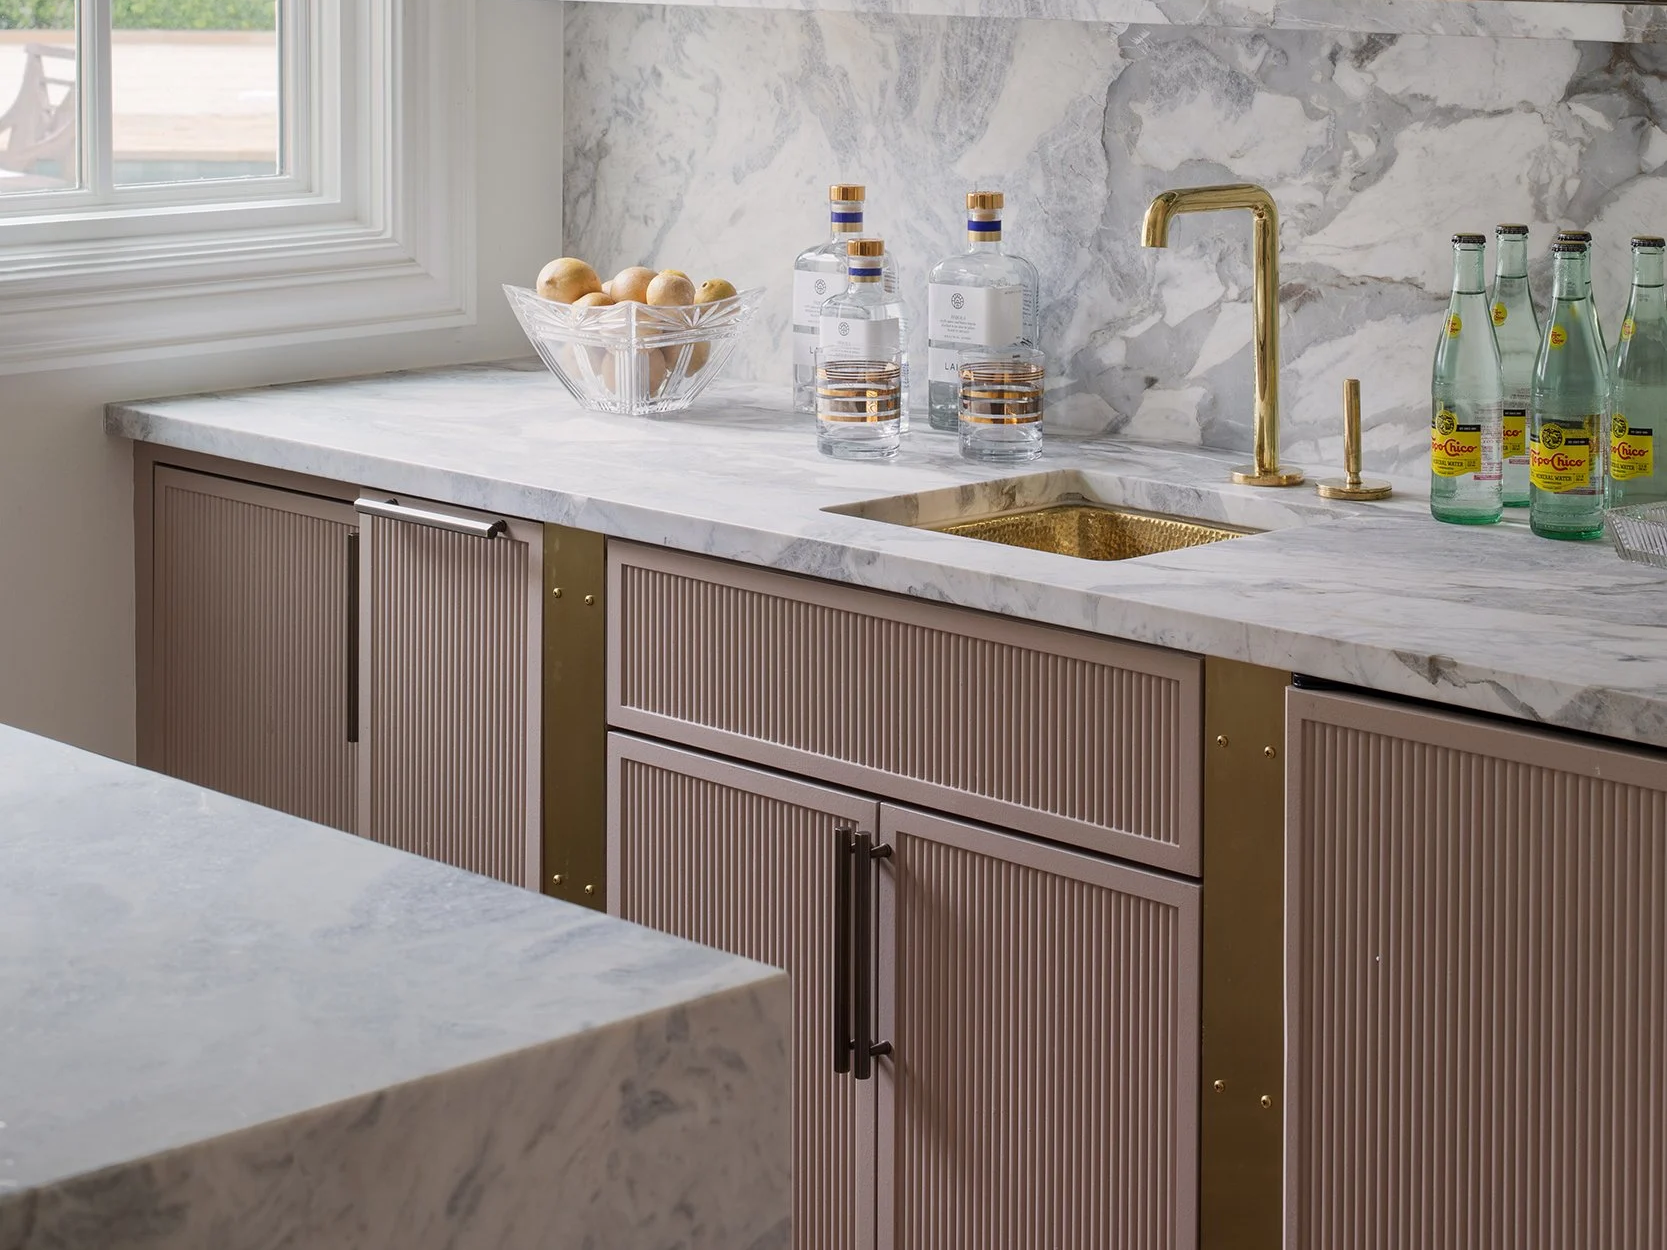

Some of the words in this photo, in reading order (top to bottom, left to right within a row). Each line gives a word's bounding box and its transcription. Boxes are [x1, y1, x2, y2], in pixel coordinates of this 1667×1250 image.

[1445, 438, 1478, 457] Chico
[1617, 441, 1649, 460] Chico
[1551, 452, 1586, 471] Chico
